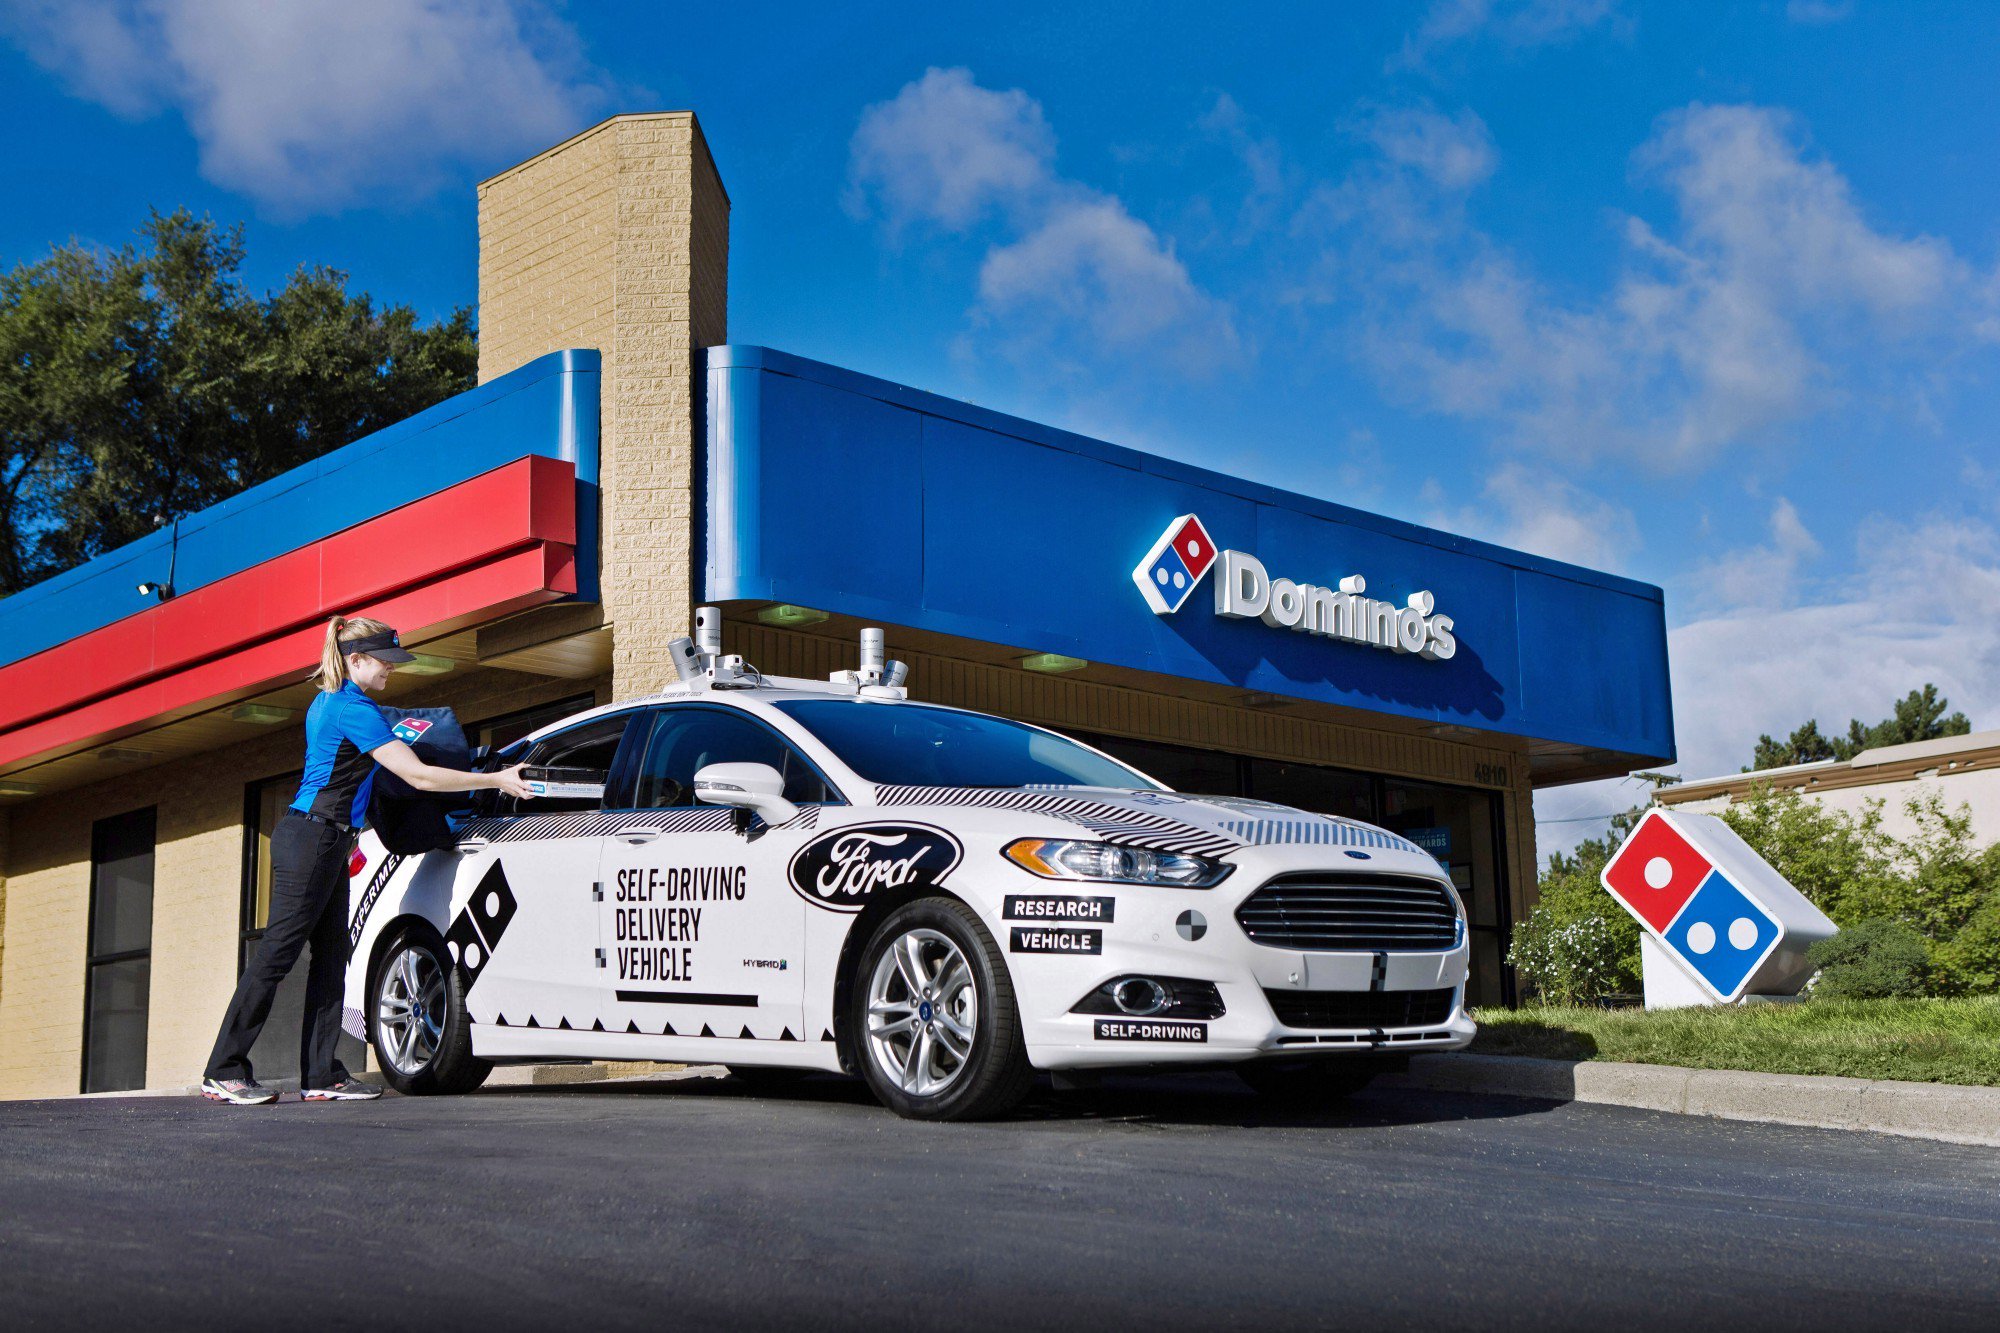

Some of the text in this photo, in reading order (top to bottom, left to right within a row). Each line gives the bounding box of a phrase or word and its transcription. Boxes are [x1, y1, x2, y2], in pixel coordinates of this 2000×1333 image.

[1214, 549, 1456, 661] Domino's
[1474, 763, 1507, 786] 4910
[1414, 838, 1447, 847] EWARDS
[816, 832, 932, 898] Ford
[616, 866, 746, 902] SELF-DRIVING
[350, 853, 401, 947] EXPERIME
[1014, 900, 1101, 918] RESEARCH
[616, 907, 702, 942] DELIVERY
[1021, 932, 1092, 950] VEHICLE
[617, 947, 692, 981] VEHICLE
[743, 958, 779, 969] HYBRID
[1101, 1023, 1201, 1040] SELF-DRIVING
